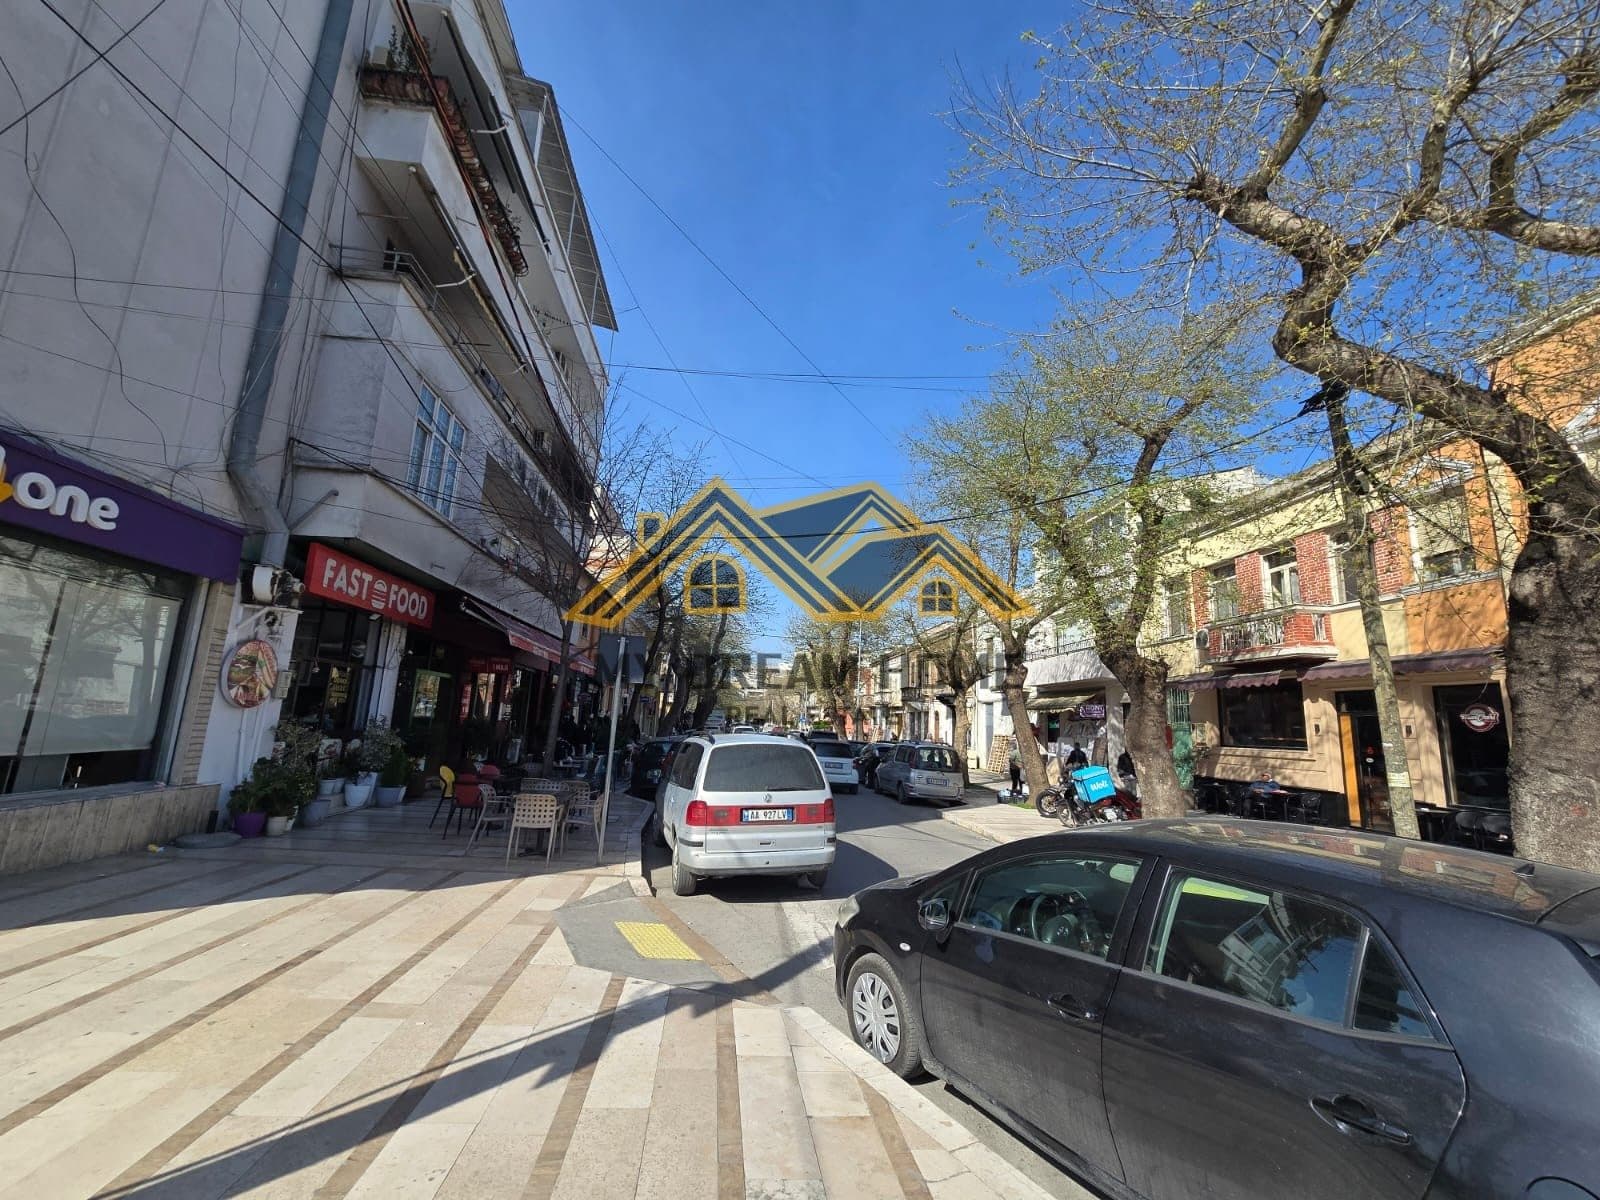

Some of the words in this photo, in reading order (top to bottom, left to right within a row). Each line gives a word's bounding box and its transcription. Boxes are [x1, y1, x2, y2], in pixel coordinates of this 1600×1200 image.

[13, 471, 120, 531] one
[322, 557, 372, 601] FAST
[388, 585, 428, 620] FOOD
